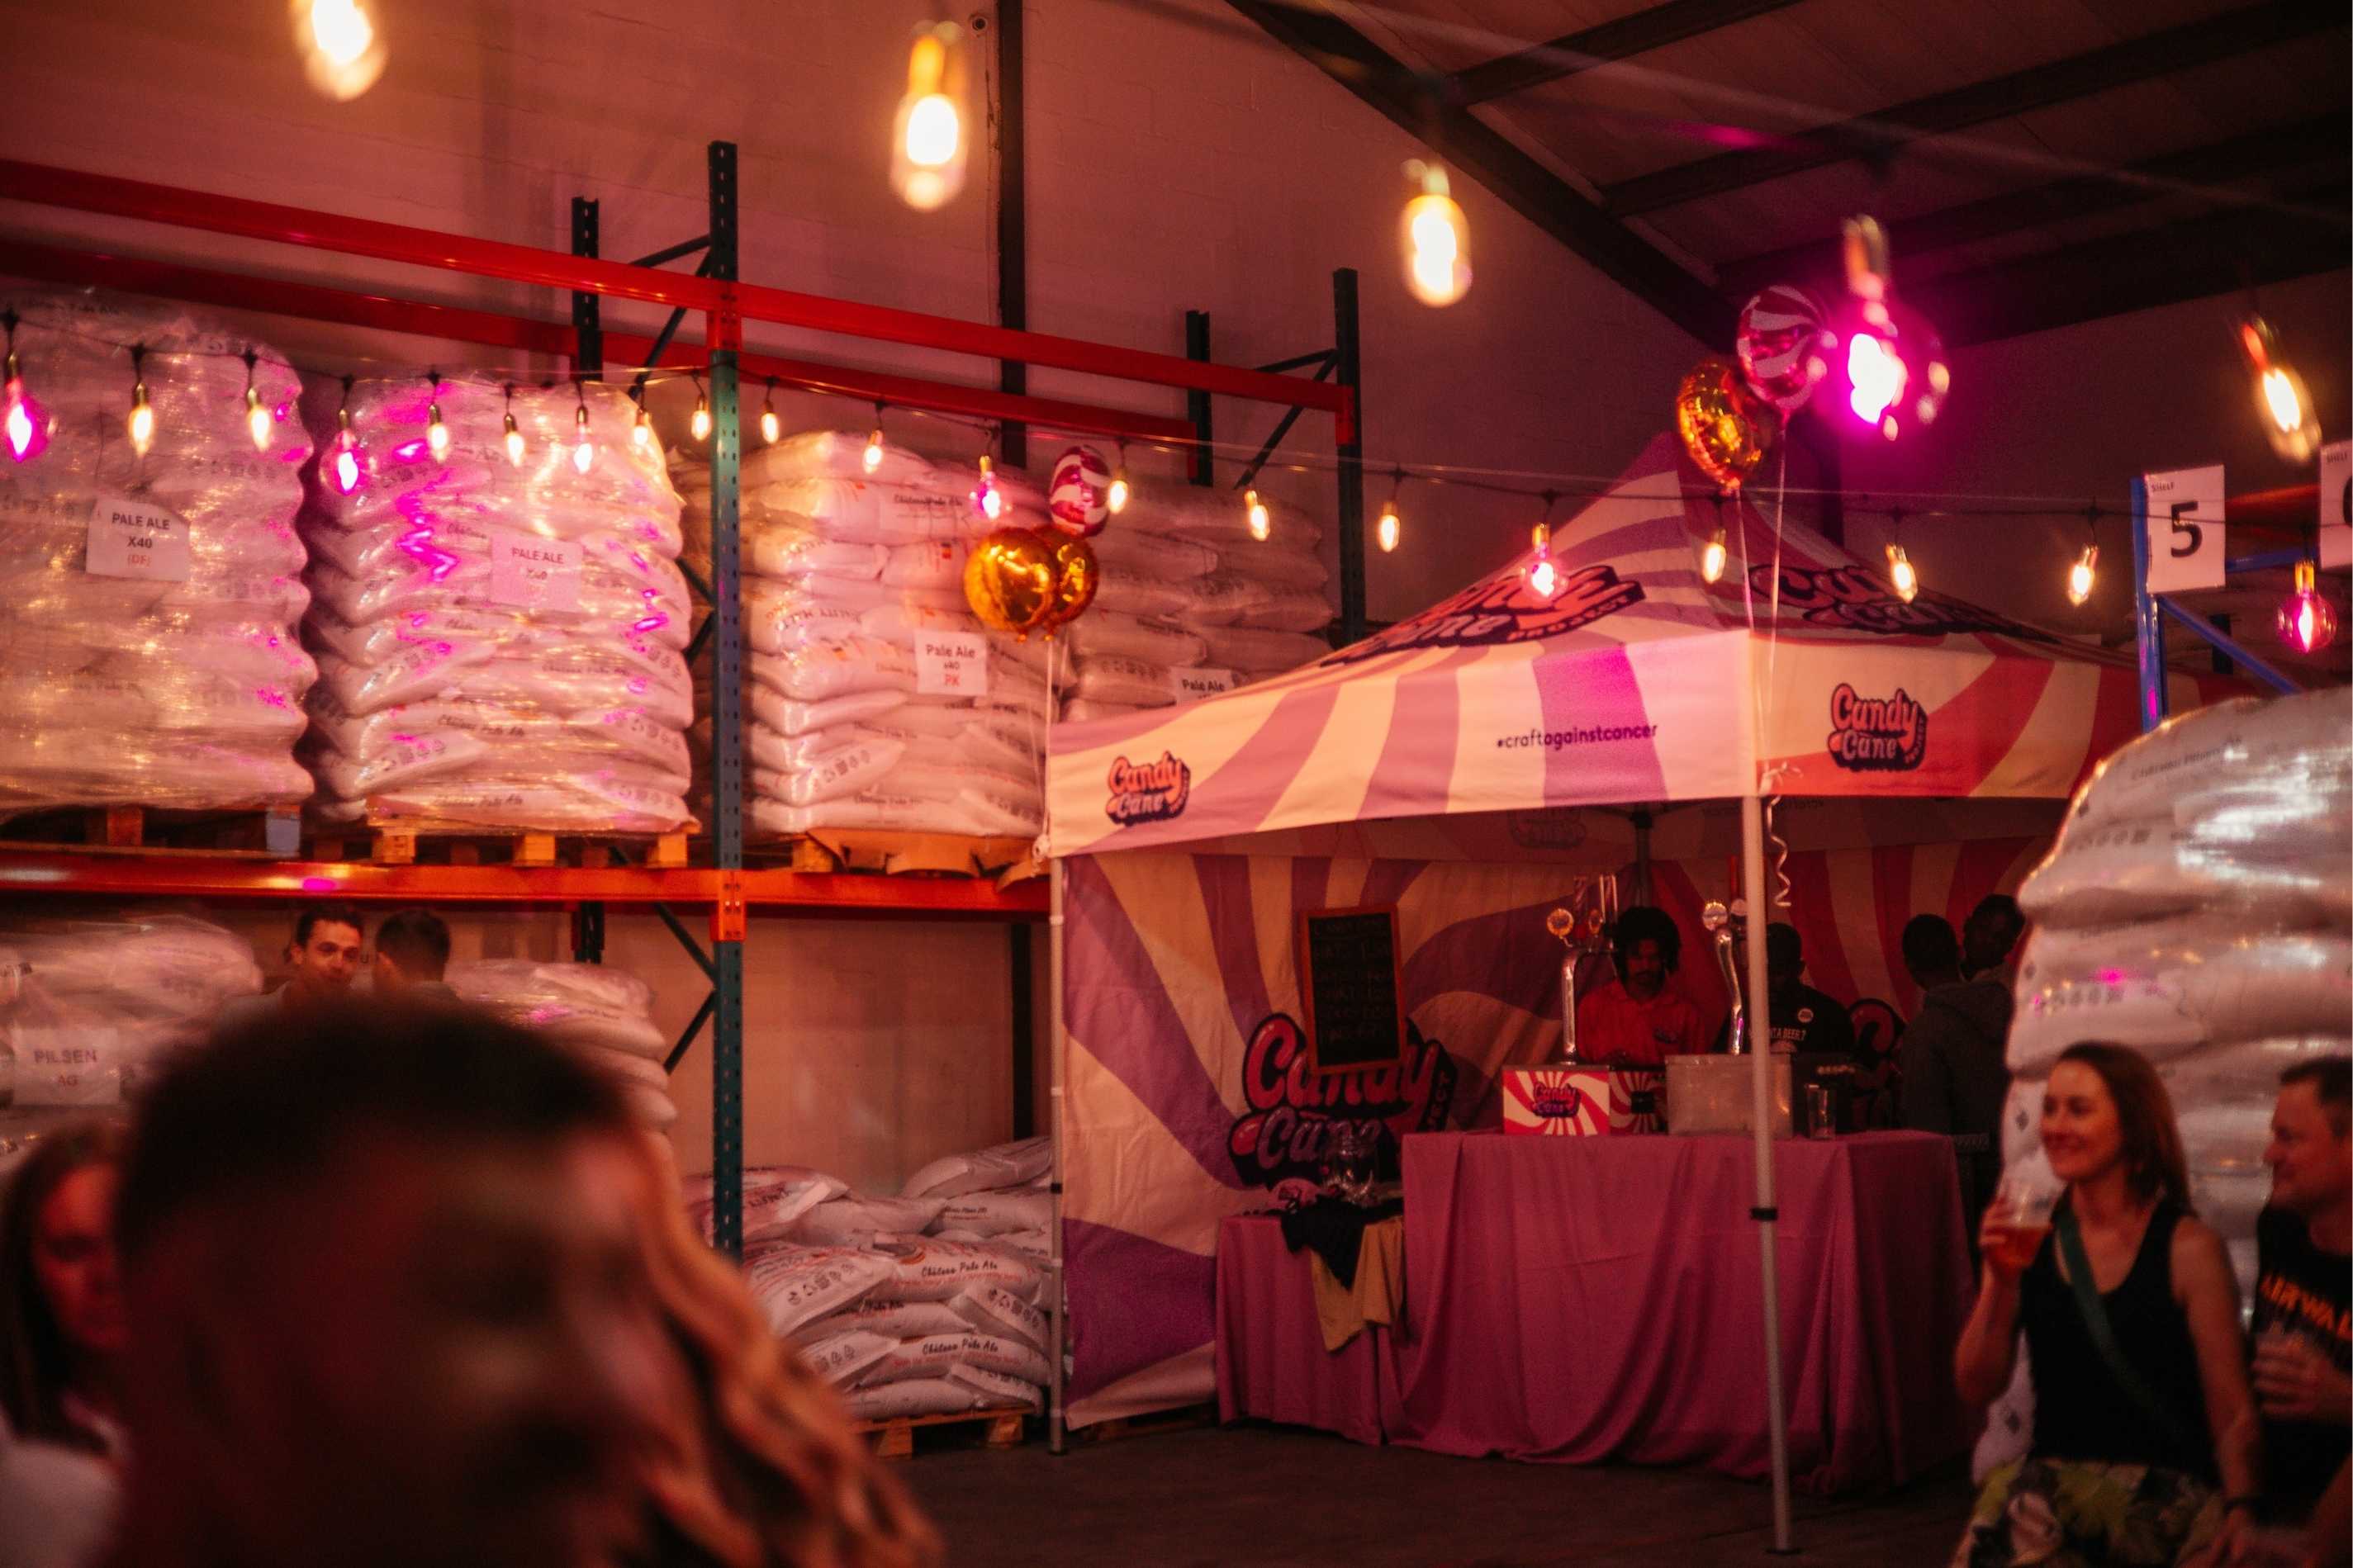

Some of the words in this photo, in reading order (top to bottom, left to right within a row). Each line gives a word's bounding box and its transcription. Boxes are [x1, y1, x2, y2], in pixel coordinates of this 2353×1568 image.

[111, 512, 144, 527] PALE
[145, 517, 171, 530] ALE
[2170, 500, 2204, 559] 5
[126, 535, 154, 549] X40
[512, 546, 541, 561] PALE
[542, 552, 565, 564] ALE
[925, 643, 953, 657] Pale
[956, 646, 976, 659] Ale
[944, 673, 961, 687] PK
[1181, 679, 1206, 691] Pale
[1207, 680, 1226, 693] Ale
[1831, 683, 1918, 751] Candy
[1497, 723, 1658, 751] #craftagainstcancer
[1842, 728, 1899, 760] Cane
[1108, 750, 1183, 804] Candy
[1116, 791, 1165, 818] Cane
[33, 1048, 98, 1064] PILSEN
[57, 1074, 79, 1087] AG
